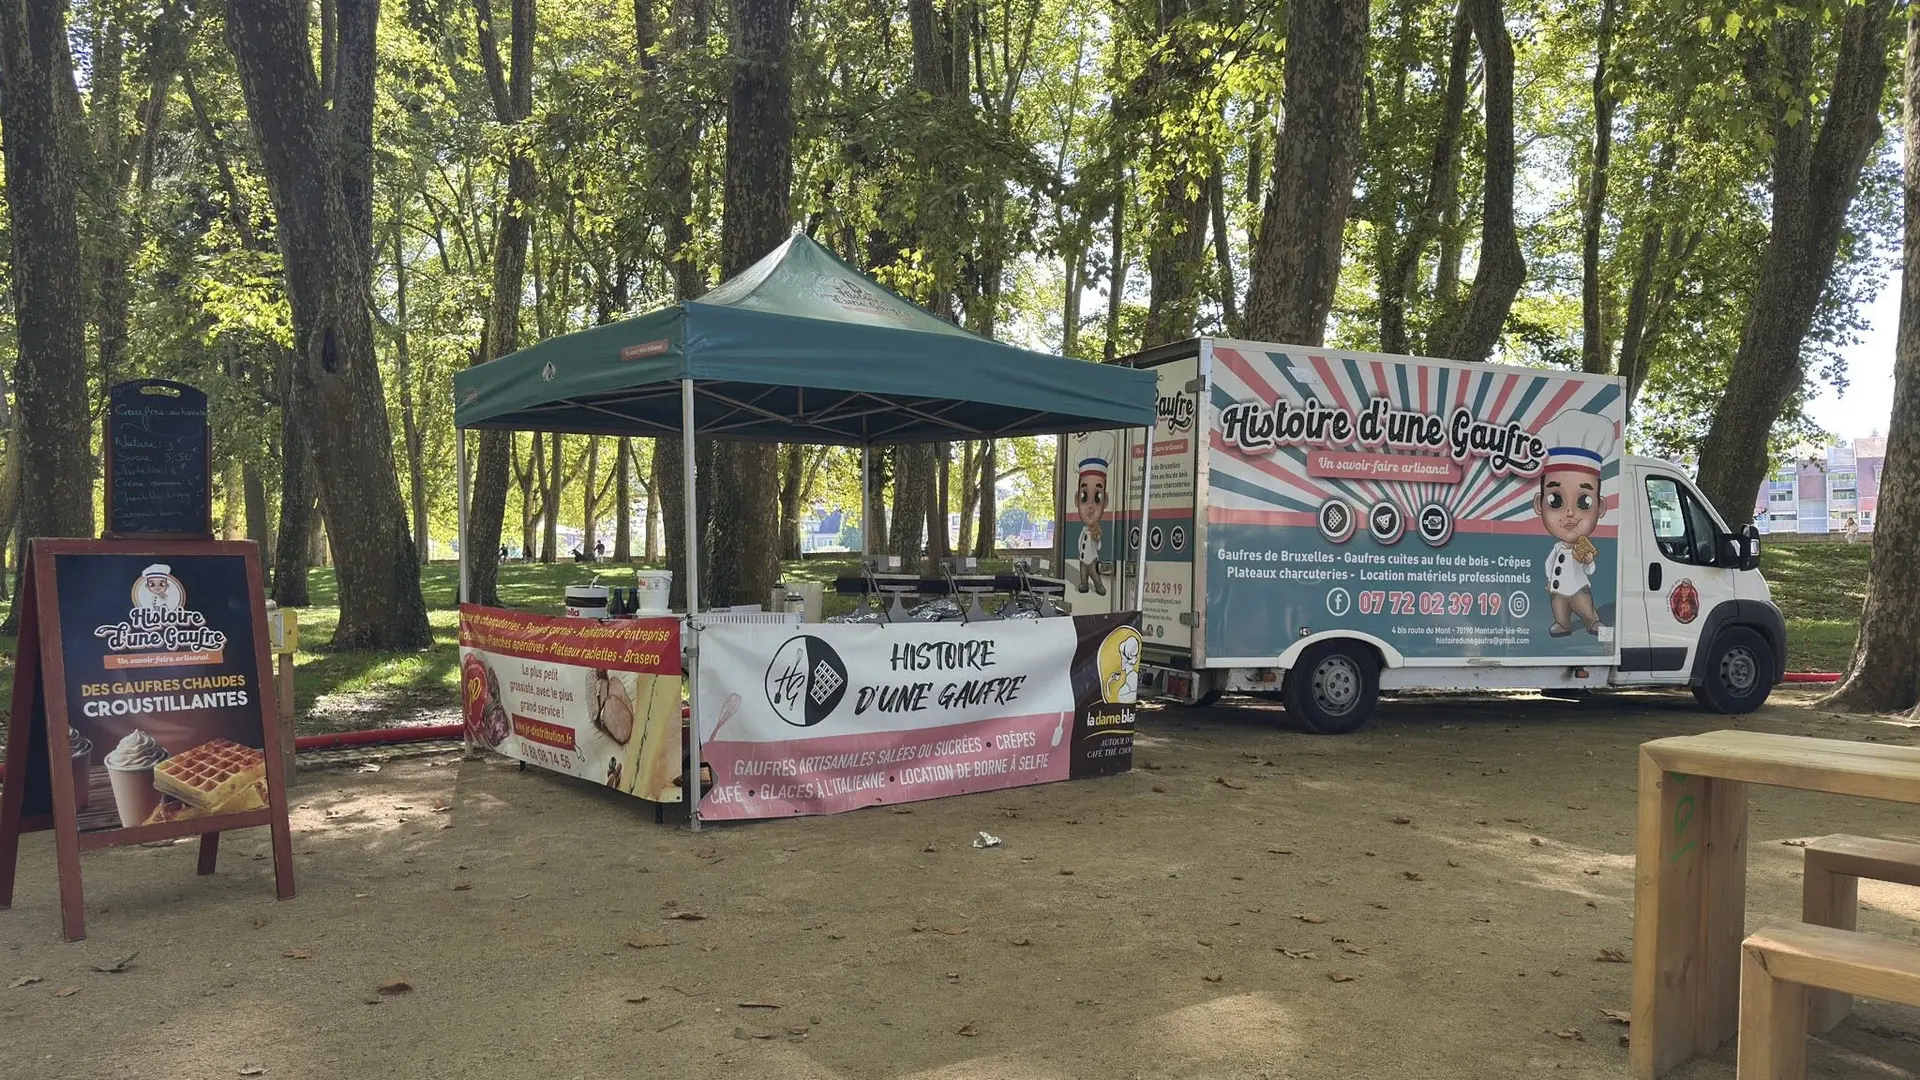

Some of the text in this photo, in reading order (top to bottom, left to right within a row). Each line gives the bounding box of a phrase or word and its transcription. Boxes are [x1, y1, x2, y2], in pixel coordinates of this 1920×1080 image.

[1222, 399, 1546, 471] Histoire d'une Gaufre
[1318, 457, 1450, 475] Un savoir-faire artisanal
[1217, 548, 1532, 569] Gaufres de Bruxelles Gaufres cuites au feu de bois Crêpes
[1227, 566, 1532, 584] Plateaux charcuteries Location matériels professionnels
[1151, 582, 1160, 593] 02
[1162, 582, 1171, 594] 39
[1173, 583, 1182, 595] 19
[1358, 590, 1502, 615] 07 72 02 39 19
[130, 607, 205, 630] Histoire
[95, 622, 226, 652] d'une Gaufre
[616, 627, 670, 644] d'entreprise
[1426, 626, 1434, 634] du
[1435, 626, 1451, 634] Mont
[117, 653, 210, 665] Un savoir-faire artisanal
[549, 642, 581, 658] Plateaux
[581, 646, 618, 662] raclettes
[623, 649, 660, 666] Brasero
[890, 639, 996, 671] HISTOIRE
[521, 663, 559, 681] Le plus petit
[82, 674, 246, 697] DES GAUFRES CHAUDES
[536, 687, 551, 697] avec
[551, 687, 558, 698] le
[559, 689, 574, 704] plus
[855, 675, 1027, 715] D'UNE GAUFRE
[83, 690, 249, 718] CROUSTILLANTES
[520, 701, 537, 713] grand
[538, 704, 561, 718] service
[1086, 712, 1095, 727] la
[1095, 710, 1121, 726] dame
[1100, 737, 1124, 747] AUTOUR
[734, 731, 1036, 777] GAUFRES ARTISANALES SALÉES OU SUCRÉES CRÊPES
[710, 753, 1050, 804] CAFÉ GLACES À L'ITALIENNE LOCATION DE BORNE À SELFIE
